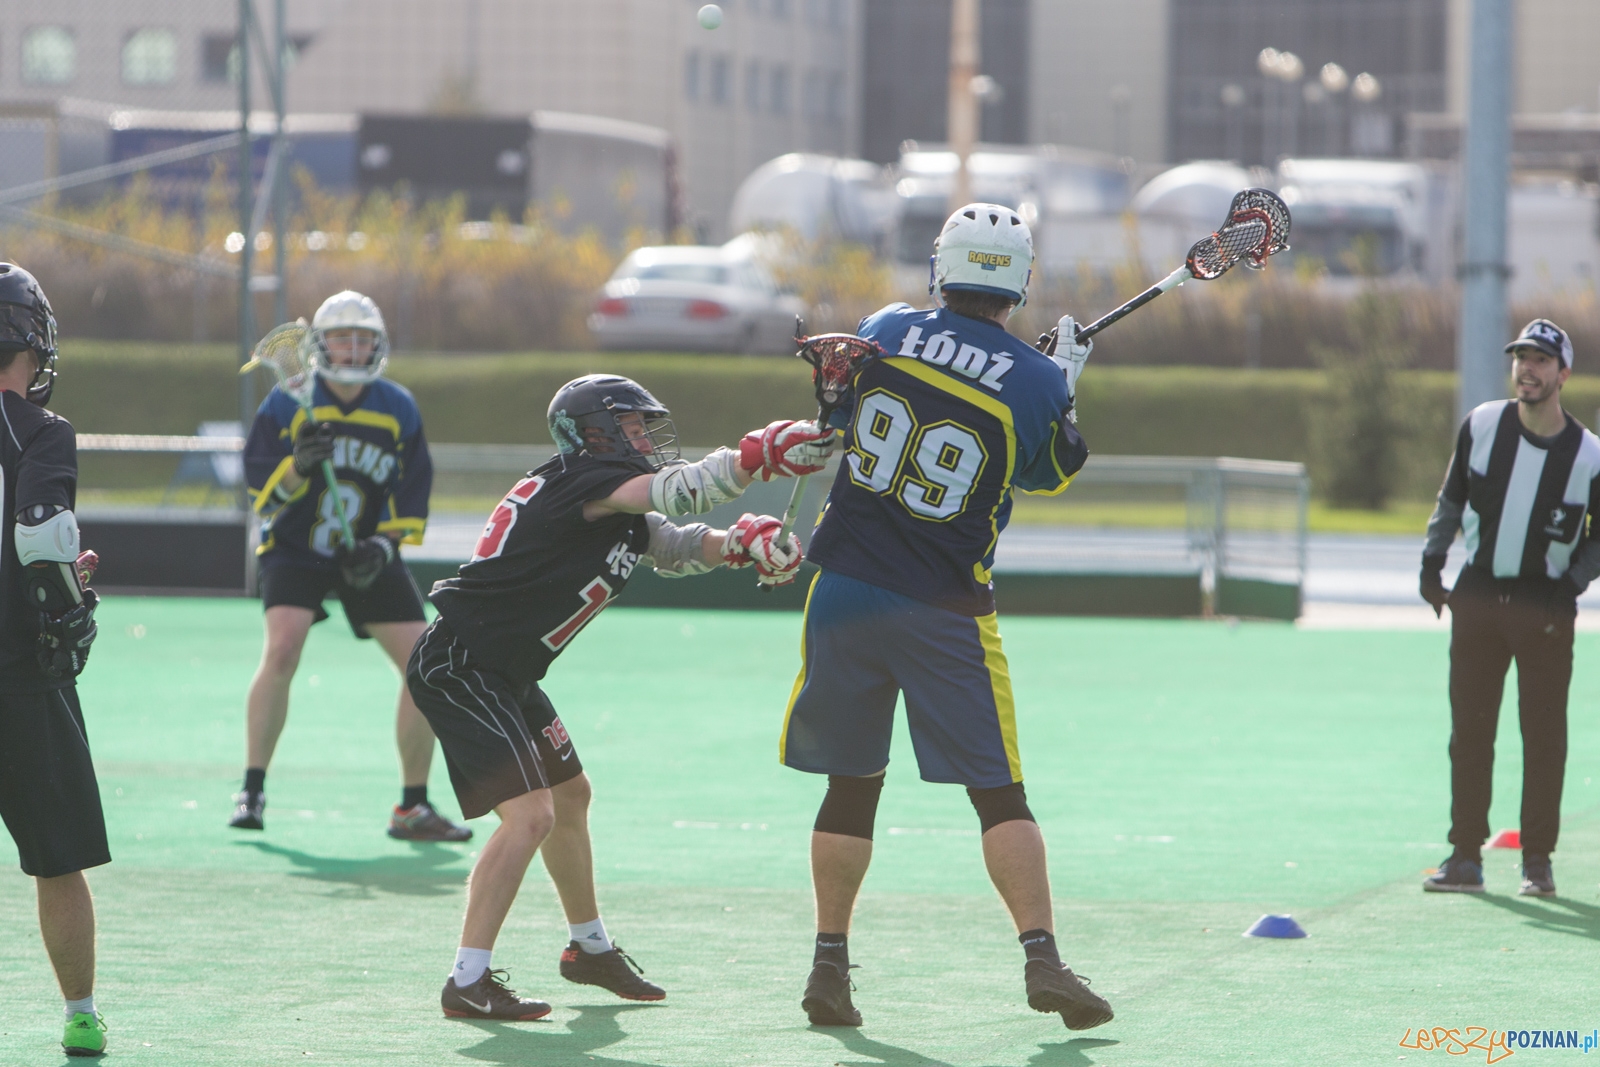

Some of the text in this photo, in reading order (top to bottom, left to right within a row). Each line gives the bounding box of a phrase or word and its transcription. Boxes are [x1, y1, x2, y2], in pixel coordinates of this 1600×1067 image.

[968, 250, 1012, 267] RAVENS
[897, 325, 1015, 393] ŁÓDŹ
[845, 387, 989, 522] 99
[541, 716, 569, 750] 16
